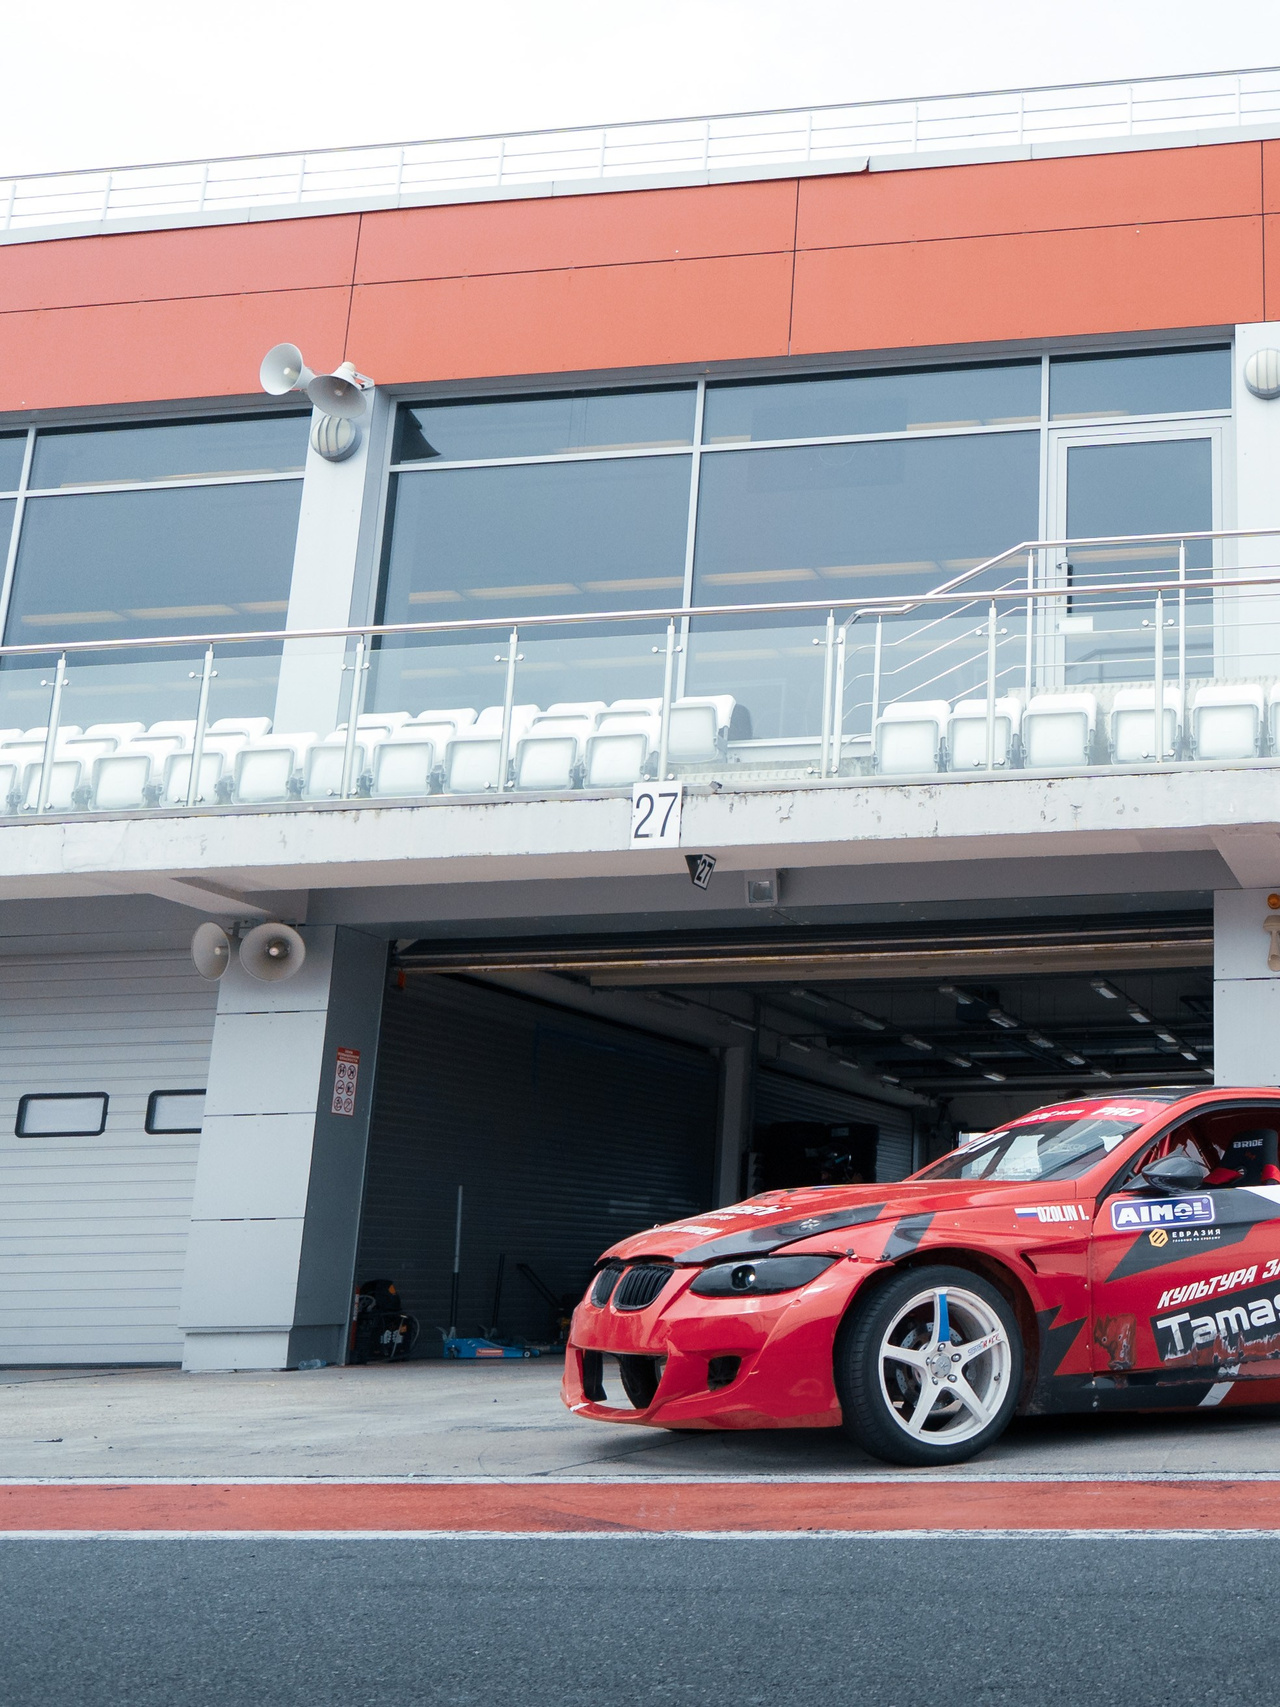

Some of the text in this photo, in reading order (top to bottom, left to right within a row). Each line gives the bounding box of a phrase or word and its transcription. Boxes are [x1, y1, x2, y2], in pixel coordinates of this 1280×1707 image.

[633, 792, 679, 839] 27
[695, 858, 713, 884] 27
[1091, 1106, 1145, 1117] PRO
[1233, 1138, 1264, 1149] BRIDE
[1036, 1205, 1079, 1223] OZOLIN
[1116, 1201, 1211, 1226] AIMOL
[1172, 1228, 1221, 1238] ЕВРАЗИЯ
[1157, 1265, 1258, 1309] КУЛЬТУРА
